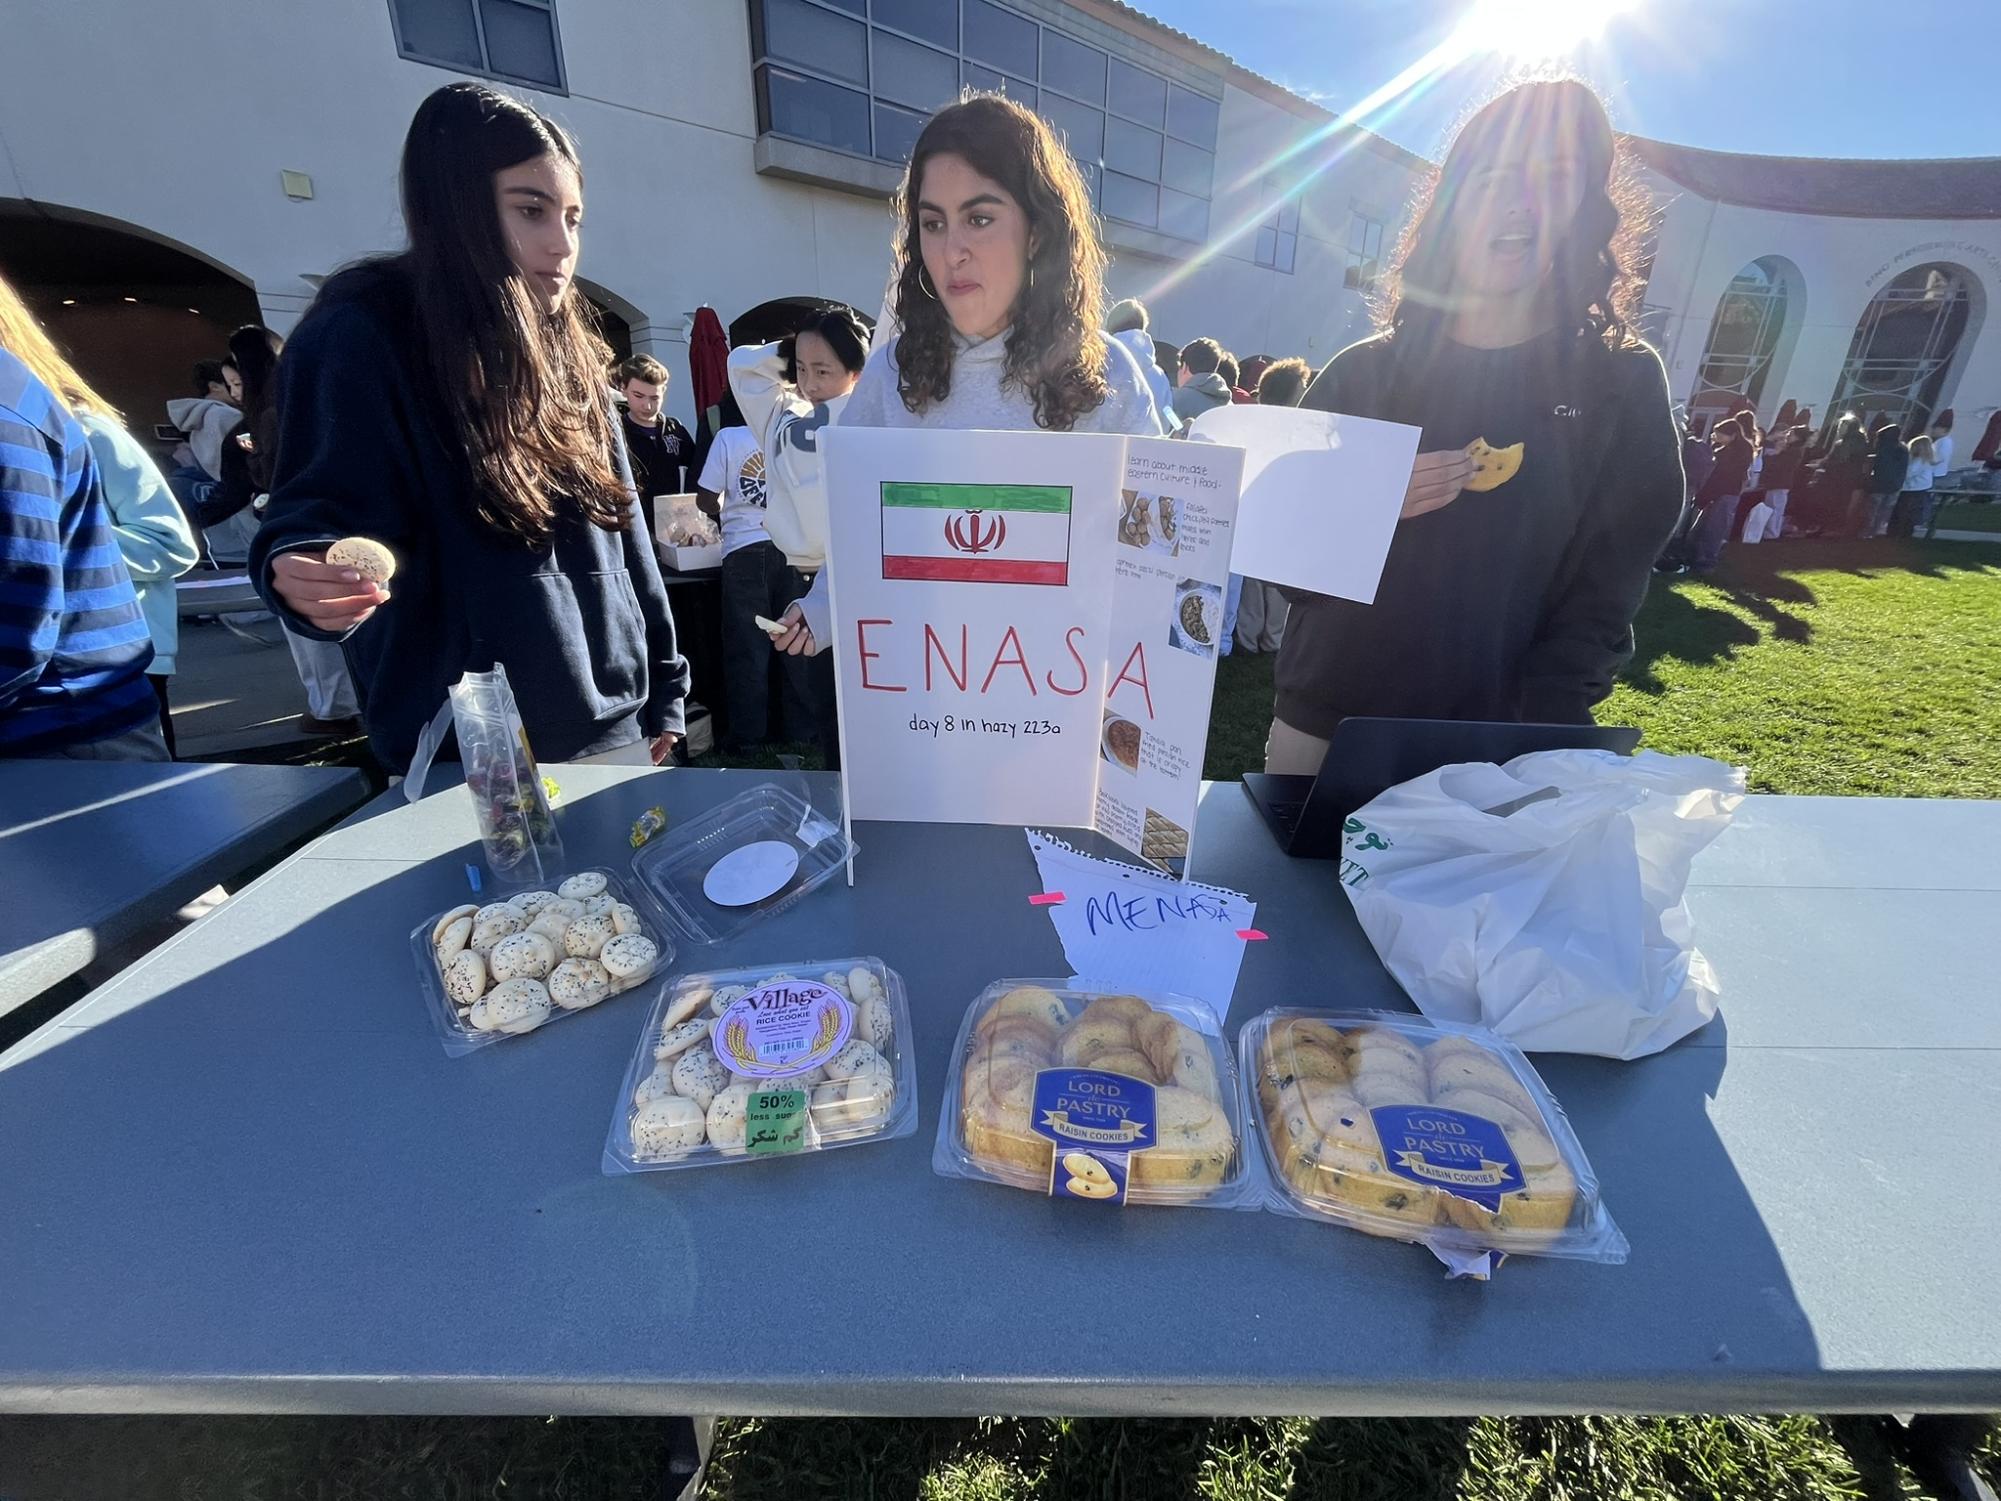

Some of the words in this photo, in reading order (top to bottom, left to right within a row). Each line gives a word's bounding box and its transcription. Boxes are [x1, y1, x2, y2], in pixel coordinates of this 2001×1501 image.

[1127, 469, 1159, 480] eastern
[1151, 460, 1176, 471] about
[857, 619, 1154, 720] ENASA
[909, 713, 940, 738] day
[944, 715, 955, 732] 8
[961, 717, 975, 732] in
[981, 718, 1016, 738] hazy
[1023, 719, 1061, 735] 223a
[1086, 891, 1232, 936] MENASA
[744, 988, 828, 1011] Village
[756, 1016, 778, 1026] RICE
[778, 1011, 811, 1023] COOKIE
[1068, 1080, 1121, 1097] LORD
[759, 1094, 795, 1109] 50%
[1057, 1097, 1131, 1119] PASTRY
[750, 1113, 770, 1121] less
[1058, 1123, 1087, 1139] RAISIN
[1089, 1131, 1129, 1142] COOKIES
[1406, 1118, 1466, 1136] LORD
[1404, 1136, 1485, 1158] PASTRY
[1417, 1164, 1451, 1180] RAISIN
[1453, 1173, 1495, 1183] COOKIES
